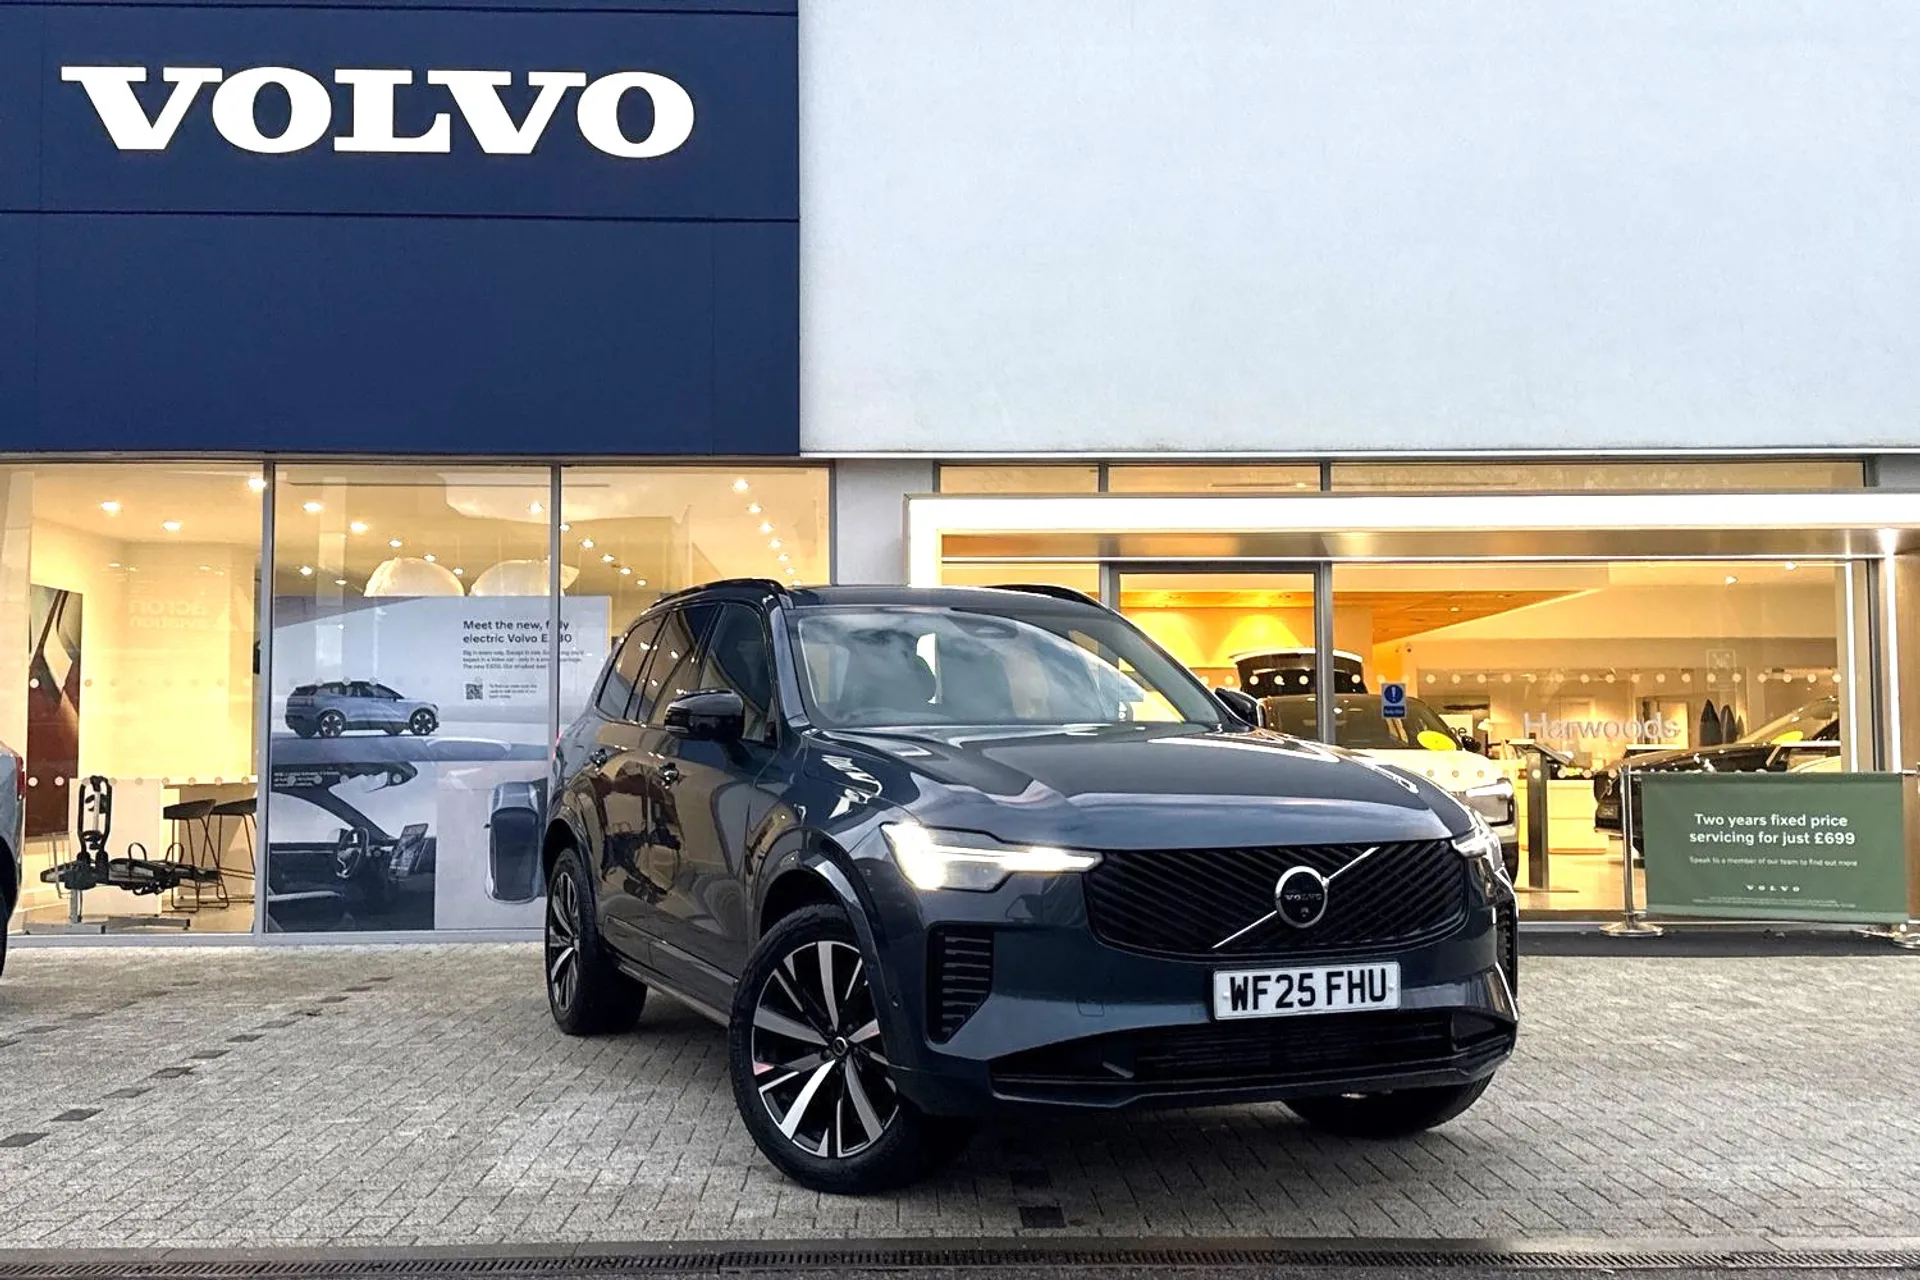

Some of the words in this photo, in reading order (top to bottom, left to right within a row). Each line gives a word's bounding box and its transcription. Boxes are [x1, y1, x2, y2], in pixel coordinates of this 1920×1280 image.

[61, 66, 695, 158] VOLVO
[463, 620, 492, 630] Meet
[495, 620, 513, 630] the
[516, 621, 543, 631] new,
[463, 633, 505, 643] electric
[507, 633, 538, 643] Volvo
[1523, 711, 1680, 739] Harwoods
[1694, 813, 1724, 826] Two
[1727, 816, 1767, 829] years
[1771, 813, 1806, 827] fixed
[1810, 814, 1848, 829] price
[1689, 831, 1754, 846] servicing
[1758, 831, 1779, 844] for
[1782, 831, 1810, 847] just
[1814, 832, 1855, 845] £699
[1758, 857, 1766, 865] of
[1779, 858, 1799, 866] team
[1809, 858, 1823, 867] find
[1744, 884, 1800, 892] VOLVO
[1229, 973, 1316, 1012] WF25
[1326, 968, 1387, 1005] FHU
